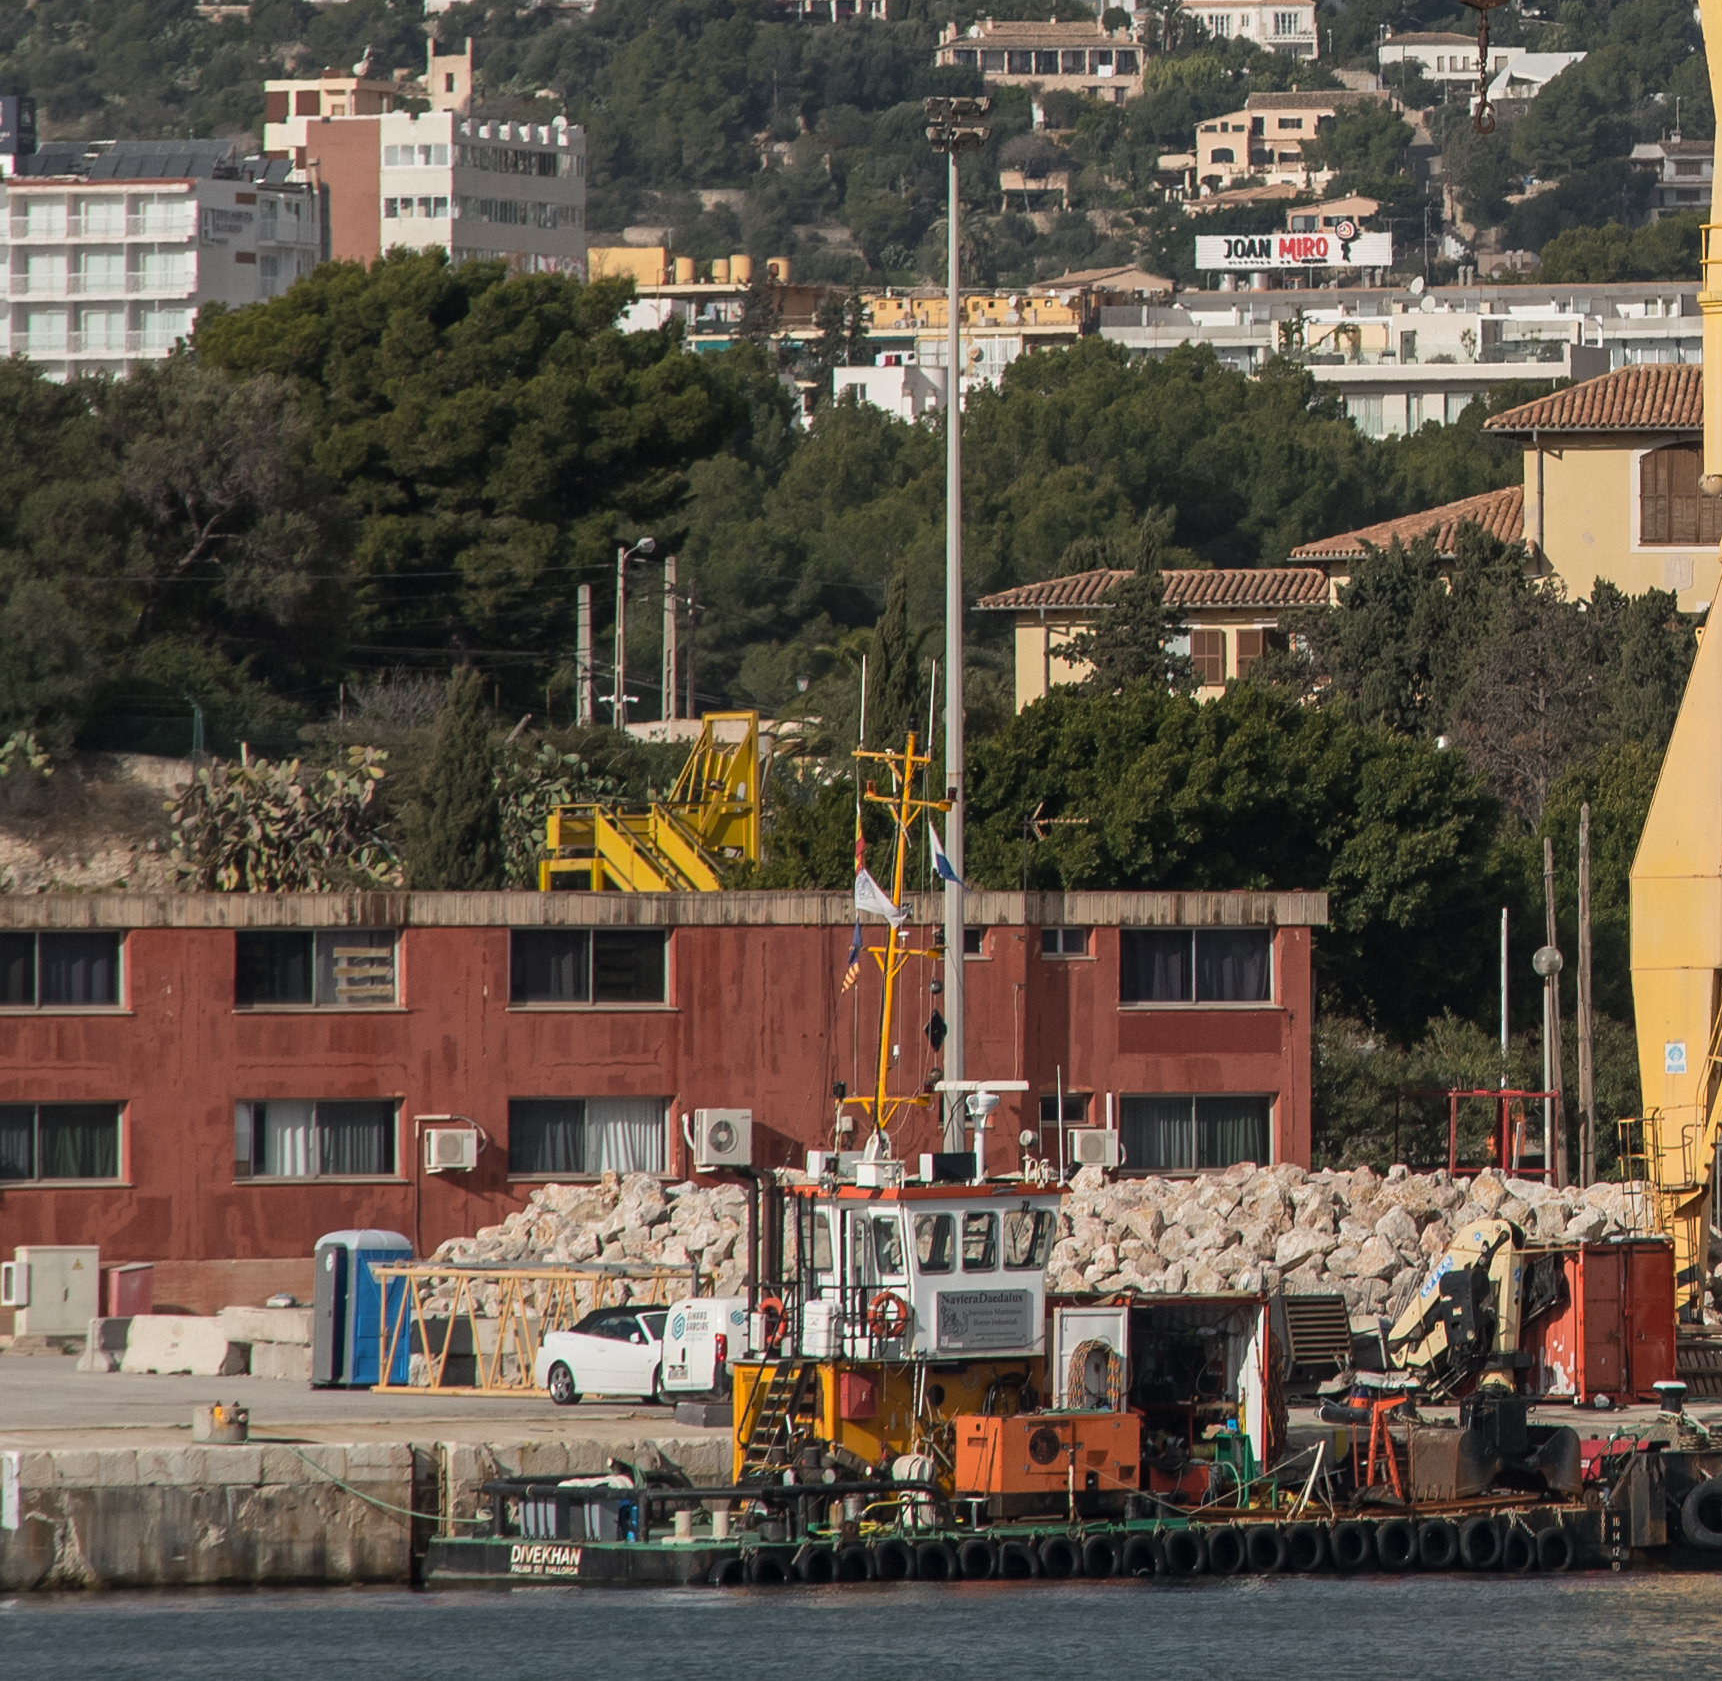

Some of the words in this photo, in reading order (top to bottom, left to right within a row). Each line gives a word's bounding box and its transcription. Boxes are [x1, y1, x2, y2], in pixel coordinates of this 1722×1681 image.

[1223, 238, 1272, 259] JOAN
[1278, 237, 1329, 263] MIRO
[1612, 1531, 1620, 1541] 14
[511, 1545, 582, 1565] DIVEKHAN
